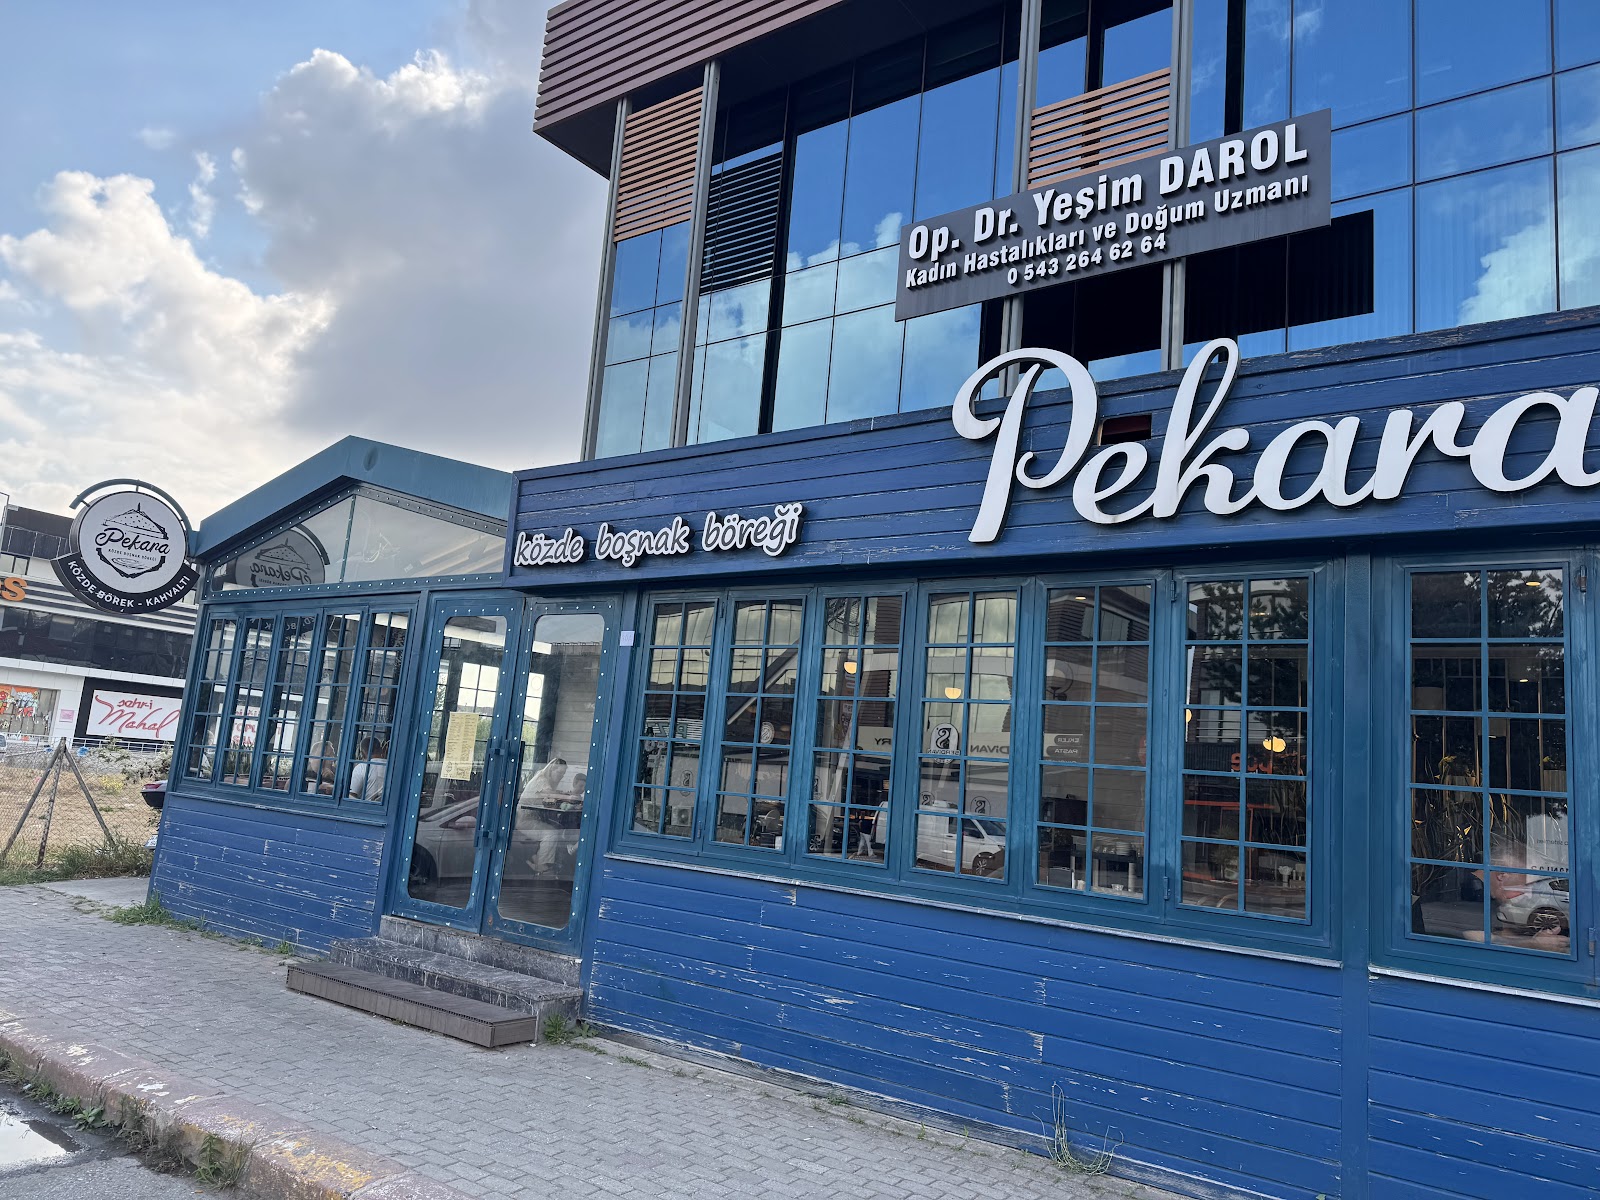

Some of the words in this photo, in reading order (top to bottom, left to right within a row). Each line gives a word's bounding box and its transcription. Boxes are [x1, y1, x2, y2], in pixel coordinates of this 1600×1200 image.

[908, 225, 960, 261] Op.
[974, 206, 1019, 245] Dr.
[1032, 172, 1143, 226] Yeşim
[1160, 123, 1308, 196] DAROL
[905, 261, 957, 289] Kadın
[963, 226, 1085, 276] Hastalıkları
[1093, 221, 1116, 243] ve
[1125, 201, 1205, 236] Doğum
[1215, 173, 1309, 213] Uzmanı
[1007, 268, 1018, 286] 0
[1024, 258, 1058, 283] 543
[1066, 249, 1102, 274] 264
[1110, 241, 1134, 265] 62
[1141, 232, 1166, 254] 64
[952, 337, 1600, 543] Pekara
[95, 527, 171, 555] Pekara
[514, 527, 585, 567] közde
[595, 515, 690, 568] boşnak
[701, 502, 804, 557] böreği
[68, 561, 97, 594] KÖZDE
[96, 590, 134, 608] BÖREK
[146, 575, 191, 607] KAHVALTI
